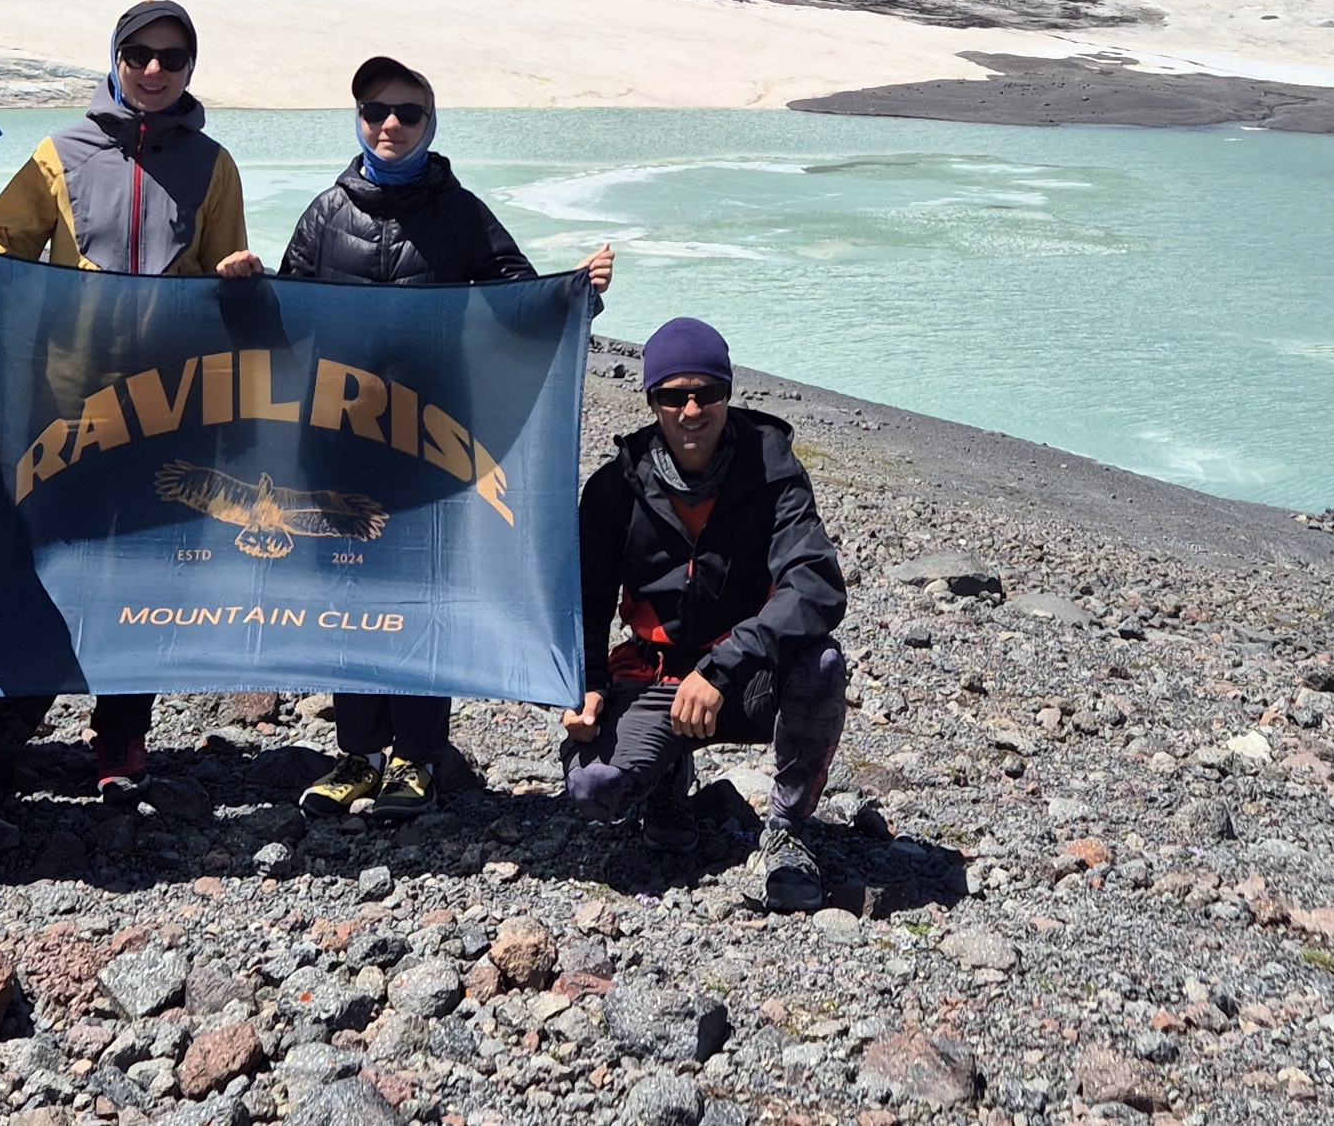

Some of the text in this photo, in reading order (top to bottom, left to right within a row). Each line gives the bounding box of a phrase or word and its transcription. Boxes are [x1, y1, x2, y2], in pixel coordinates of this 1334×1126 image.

[16, 349, 515, 526] RAVIL RISE
[177, 549, 364, 564] ESTD 2024
[119, 606, 404, 632] MOUNTAIN CLUB
